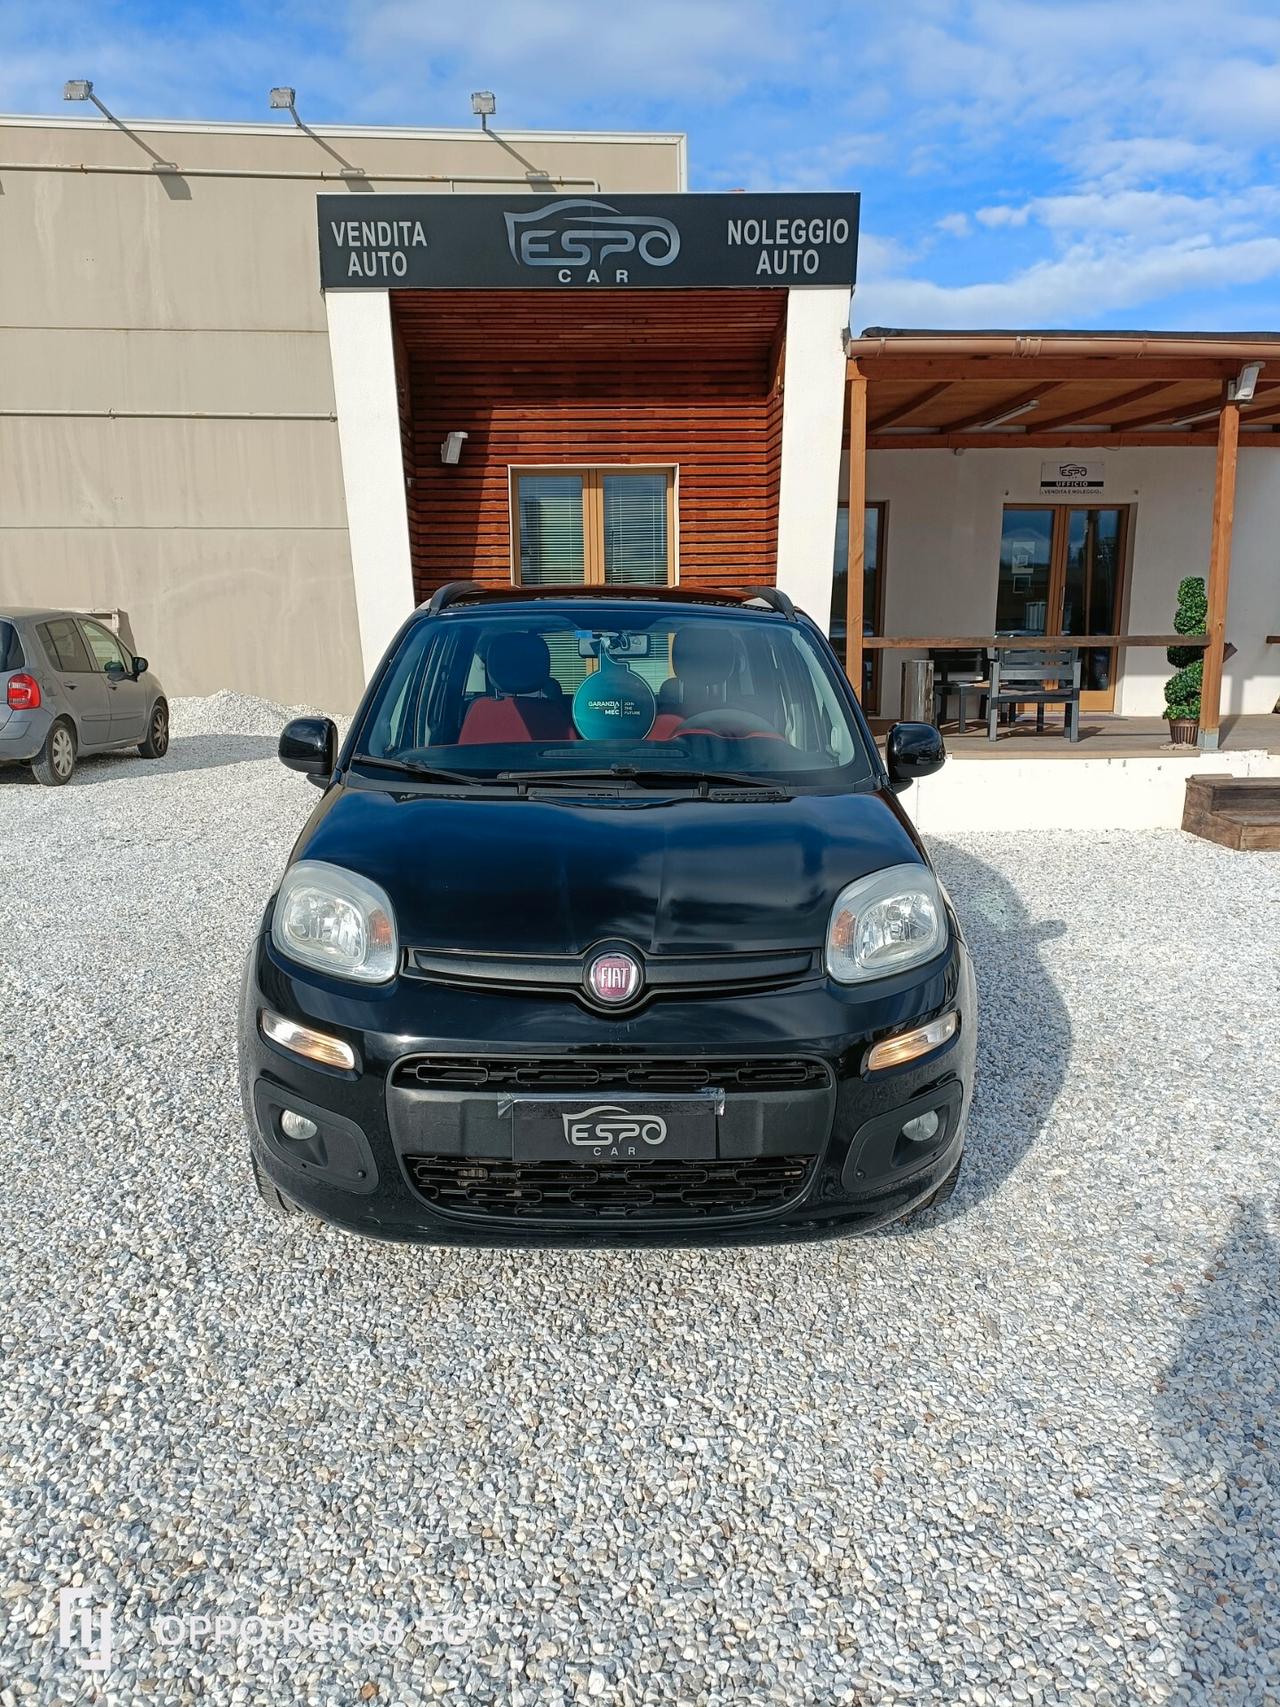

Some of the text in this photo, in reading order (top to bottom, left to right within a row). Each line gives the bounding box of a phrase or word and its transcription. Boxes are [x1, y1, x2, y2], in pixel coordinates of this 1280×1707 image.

[330, 221, 428, 247] VENDITA
[515, 216, 681, 267] ESPO
[727, 218, 850, 246] NOLEGGIO
[347, 251, 408, 277] AUTO
[756, 250, 820, 276] AUTO
[557, 269, 630, 284] CAR
[1060, 466, 1088, 477] ESPO
[601, 967, 629, 988] FIAT
[568, 1115, 667, 1146] ESPO
[593, 1146, 636, 1156] CAR
